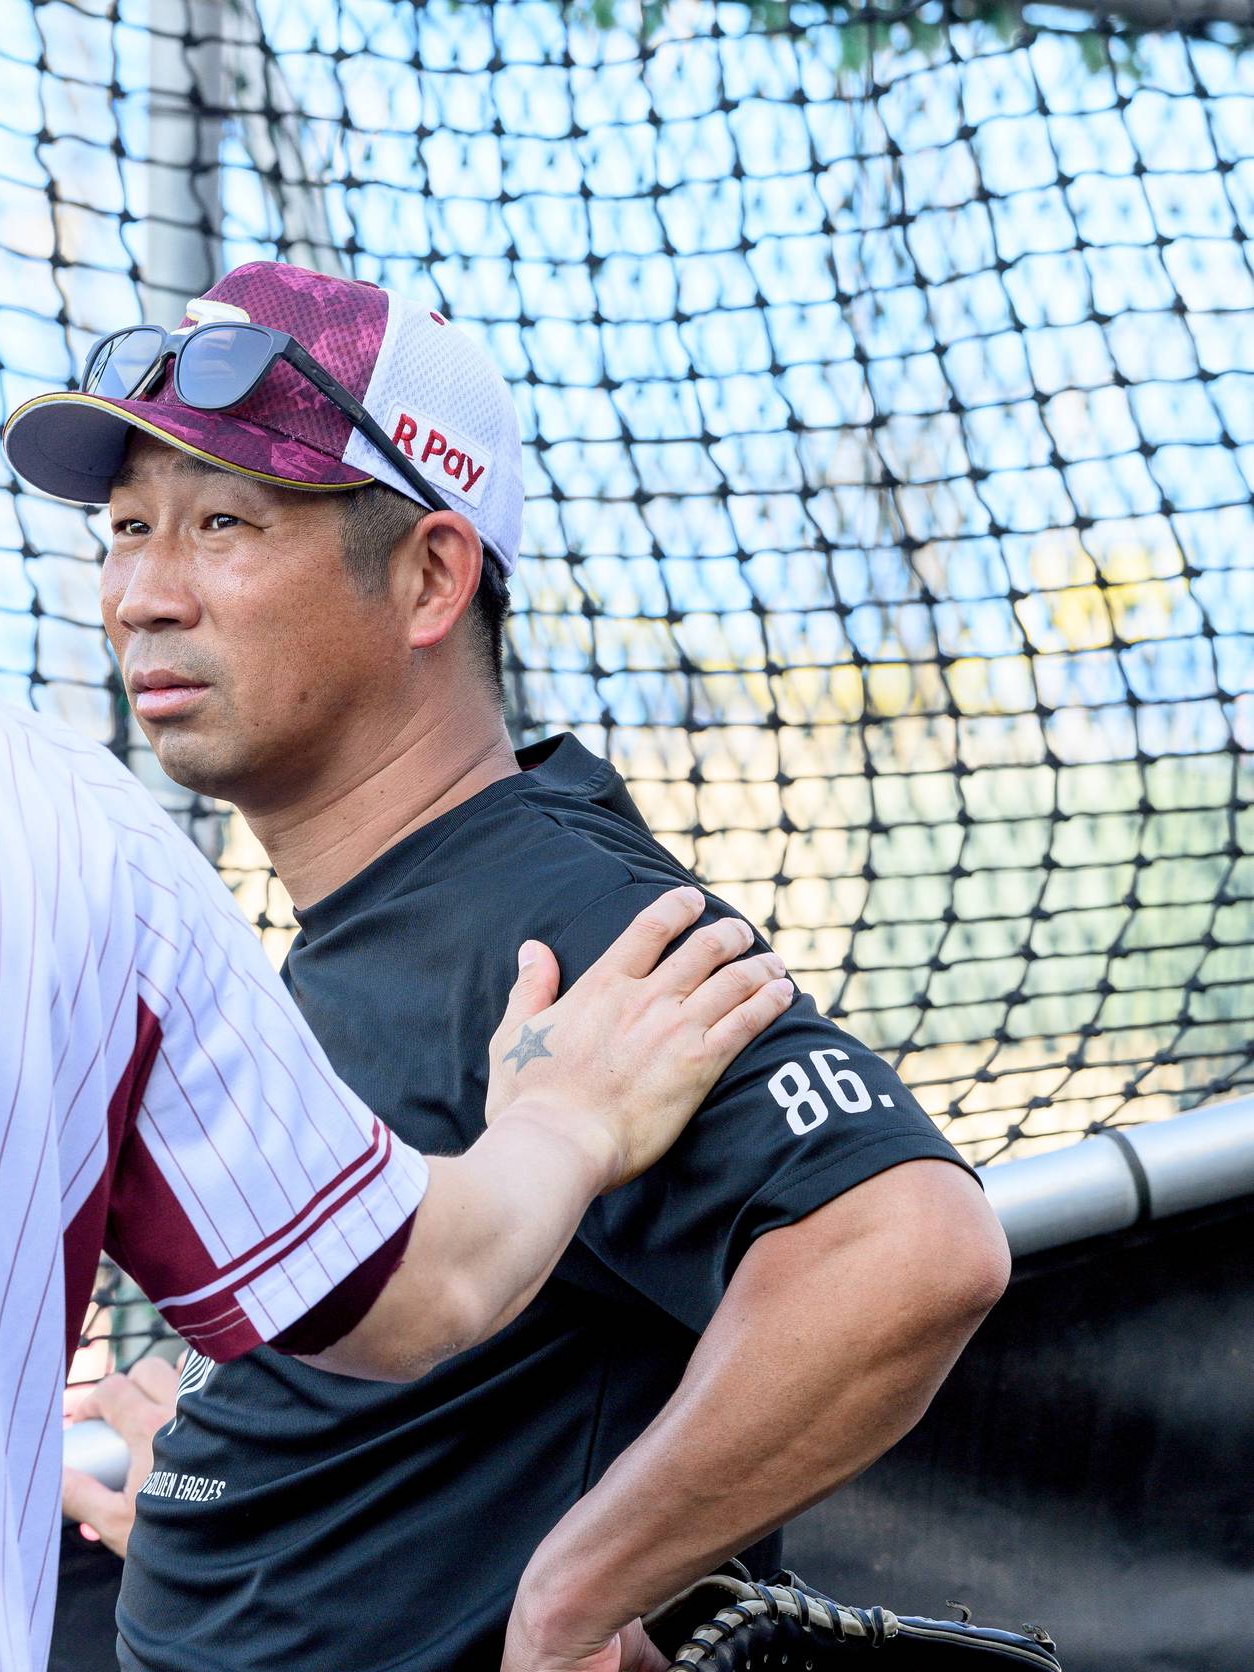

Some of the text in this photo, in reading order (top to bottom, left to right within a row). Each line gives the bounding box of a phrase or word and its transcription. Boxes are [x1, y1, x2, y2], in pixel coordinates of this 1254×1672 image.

[392, 412, 485, 493] R Pay
[767, 1048, 895, 1136] 86.
[174, 1474, 226, 1502] EAGLES
